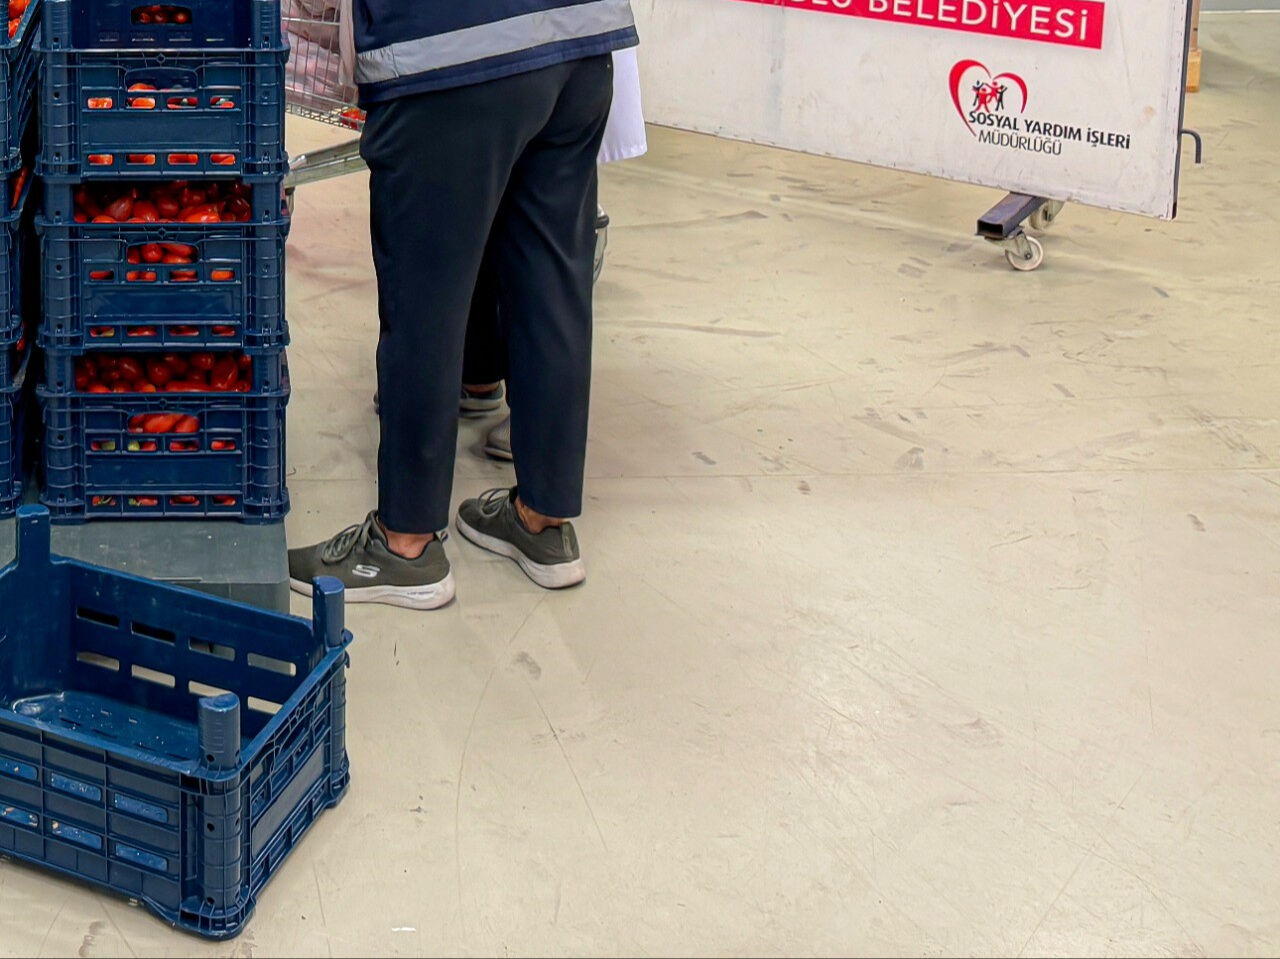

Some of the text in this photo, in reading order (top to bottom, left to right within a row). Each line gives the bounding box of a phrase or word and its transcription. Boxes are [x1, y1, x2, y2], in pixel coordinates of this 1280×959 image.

[969, 110, 1131, 149] SOSYAL YARDIM İŞLERİ
[978, 129, 1063, 156] MÜDÜRLÜĞÜ
